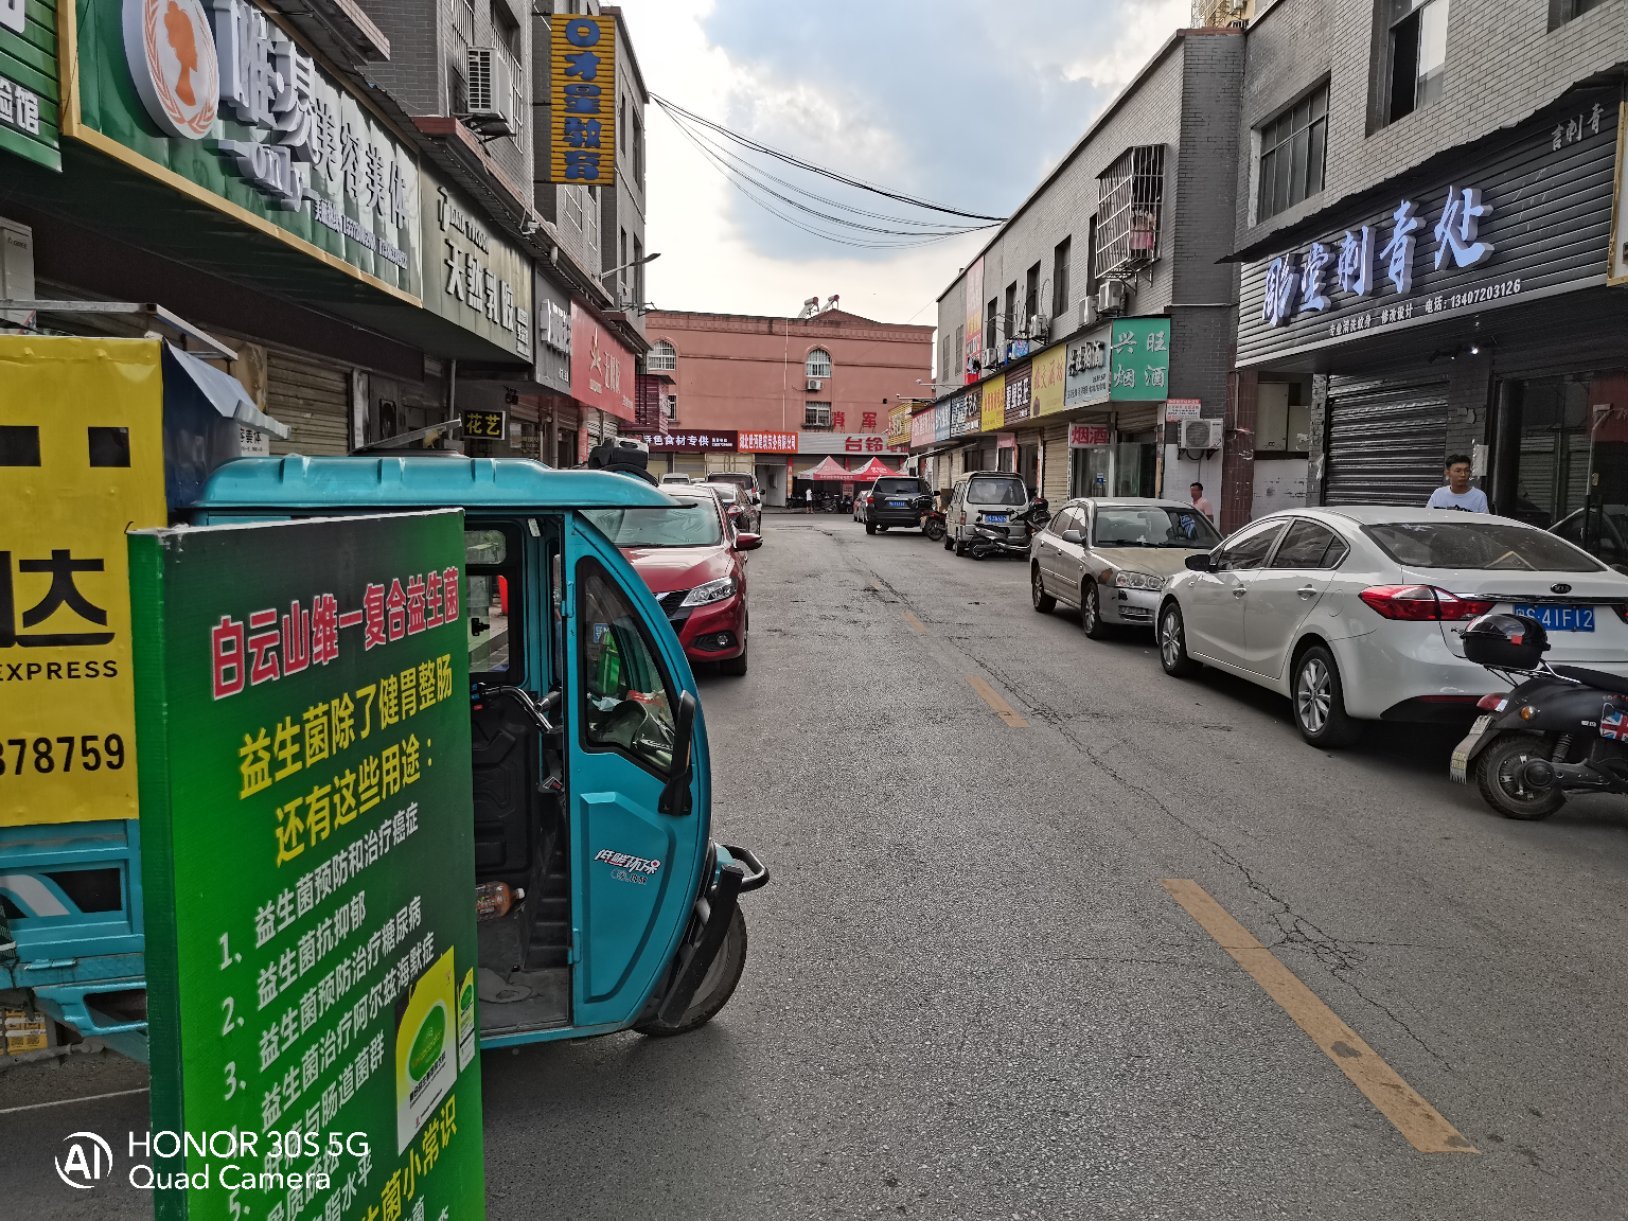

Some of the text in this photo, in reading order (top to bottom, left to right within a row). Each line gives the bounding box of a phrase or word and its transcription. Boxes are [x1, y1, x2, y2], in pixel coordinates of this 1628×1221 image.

[445, 239, 514, 332] 天然乳胶
[1112, 330, 1168, 354] 兴旺
[1113, 363, 1168, 389] 烟酒
[467, 413, 501, 436] 花艺
[1072, 426, 1110, 445] 烟酒
[210, 566, 460, 701] 白云山维一复合益生菌
[239, 654, 453, 800] 益生菌除了健胃整肠
